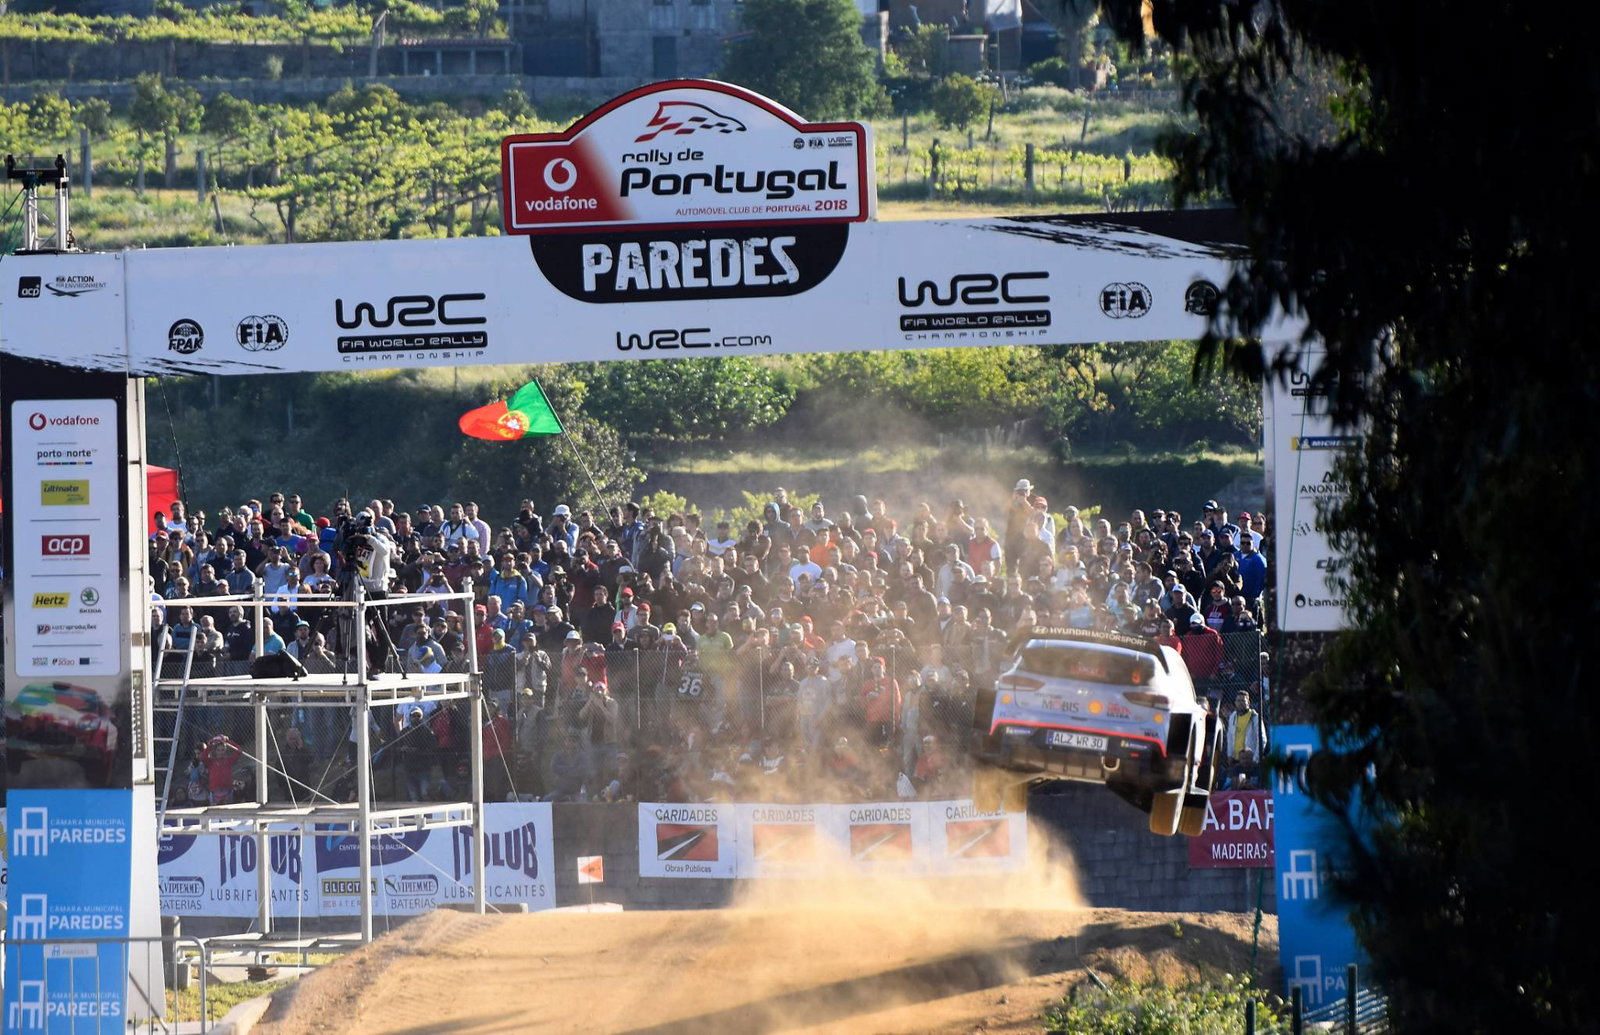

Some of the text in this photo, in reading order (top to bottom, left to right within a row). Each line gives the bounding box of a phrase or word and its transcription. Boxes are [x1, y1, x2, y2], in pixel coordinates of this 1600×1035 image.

[622, 148, 704, 165] rally de
[620, 160, 847, 200] Portugal
[525, 196, 598, 212] vodafone
[675, 199, 848, 216] AUTOMÓVEL CLUB DE PORTUGAL 2018
[582, 236, 800, 292] PAREDES
[67, 275, 95, 283] ACTION
[21, 287, 40, 298] acp
[898, 270, 1051, 307] WRC
[335, 292, 487, 329] WRC
[904, 314, 1047, 327] FIA WORLD RALLY
[341, 335, 484, 349] FIA WORLD RALLY
[904, 329, 1047, 341] CHAMPIONSHIP
[342, 350, 485, 363] CHAMPIONSHIP
[49, 415, 100, 426] vodafone
[37, 448, 92, 460] porto norte
[48, 537, 83, 554] acp
[34, 594, 66, 606] Hertz
[1049, 626, 1148, 647] HYUNDAI MOTORSPORT
[678, 675, 703, 697] 36
[1054, 732, 1073, 744] ALZ
[1076, 734, 1089, 745] WR
[85, 817, 126, 826] MUNICIPAL
[655, 808, 718, 822] CARIDADES
[752, 808, 815, 822] CARIDADES
[849, 807, 912, 823] CARIDADES
[50, 828, 126, 844] PAREDES
[219, 818, 302, 887] ITOUB
[1211, 841, 1268, 860] MADEIRAS
[665, 863, 712, 874] Obras Públicas
[324, 881, 377, 894] ELECTA
[210, 888, 309, 902] LUBRIFIANTES
[83, 905, 123, 913] MUNICIPAL
[391, 898, 436, 910] BATERIAS
[49, 915, 124, 930] PAREDES
[46, 1001, 121, 1017] PAREDES
